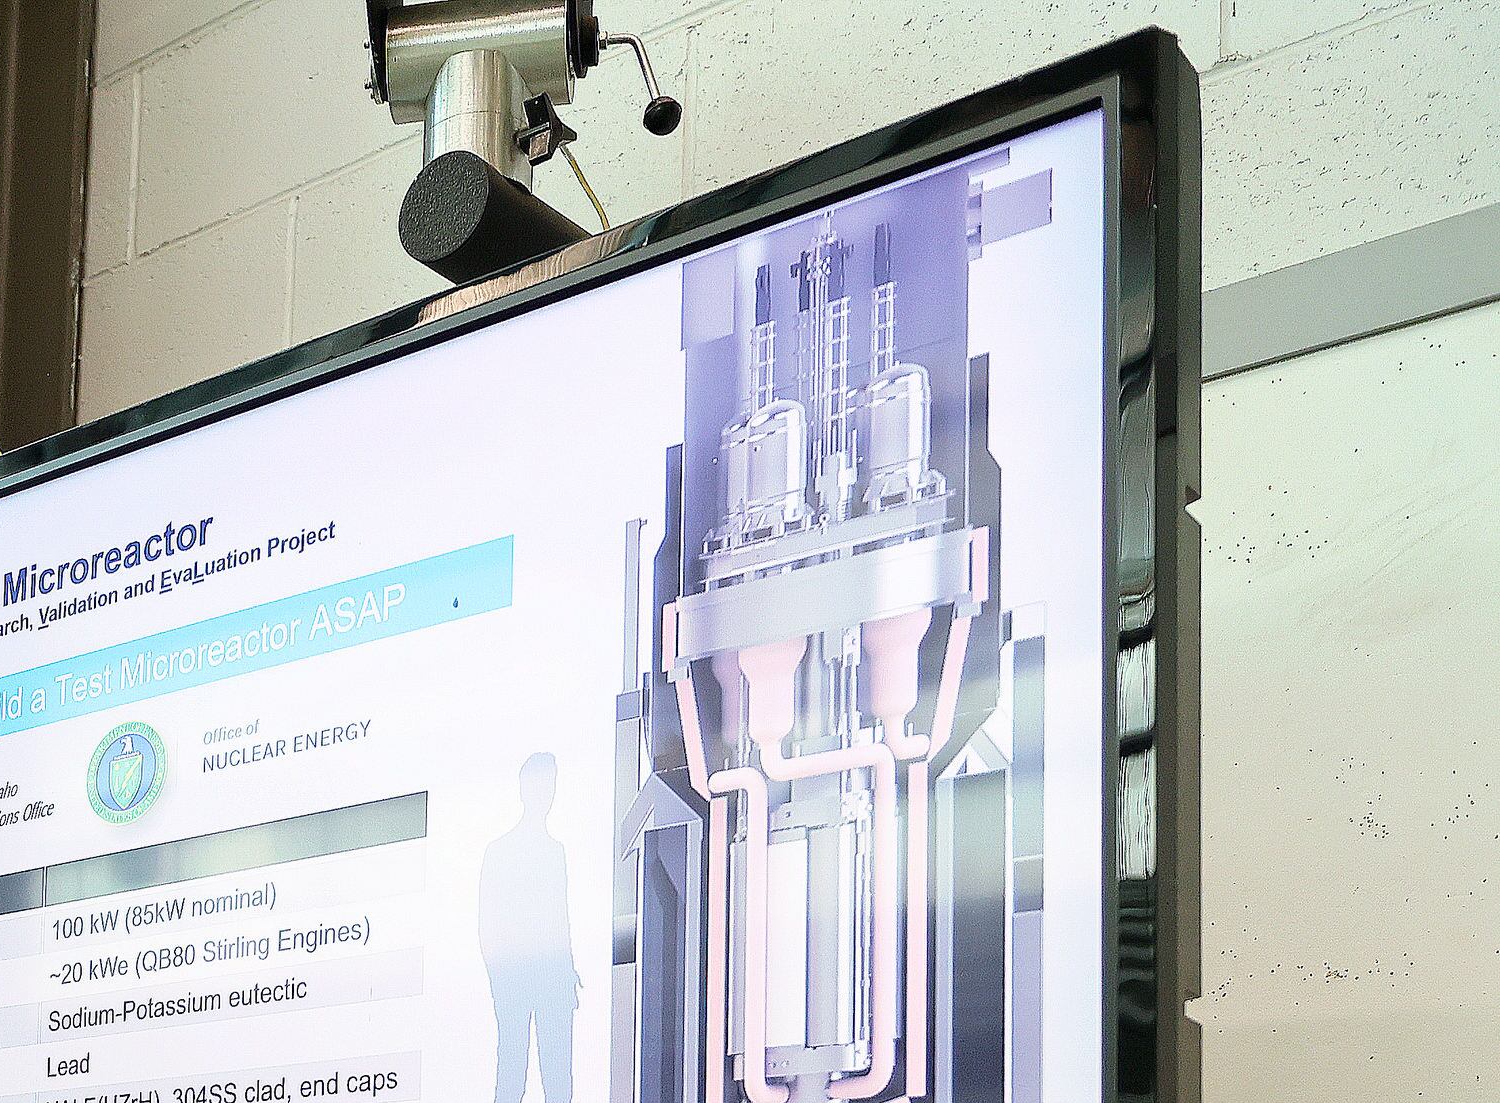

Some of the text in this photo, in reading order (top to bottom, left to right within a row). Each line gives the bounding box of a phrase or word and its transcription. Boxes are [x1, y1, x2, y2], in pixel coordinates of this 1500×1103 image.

[3, 517, 213, 607] Microreactor
[38, 588, 118, 630] Validation
[124, 575, 155, 600] and
[159, 547, 261, 594] EvaLuation
[267, 520, 336, 554] Project
[30, 687, 47, 713] a
[54, 663, 114, 706] Test
[120, 617, 302, 690] Microreactor
[309, 583, 406, 640] ASAP
[202, 718, 260, 746] Office of
[202, 719, 372, 773] NUCLEAR ENERGY
[22, 801, 55, 821] Office
[52, 882, 276, 940] 100 kW (85kW nominal)
[50, 916, 371, 985] ~20 kWe (QB80 Stirling Engines)
[48, 978, 307, 1032] Sodium-Potassium eutectic
[47, 1052, 90, 1078] Lead
[244, 1077, 291, 1103] clad,
[300, 1072, 339, 1098] end
[347, 1070, 398, 1096] caps
